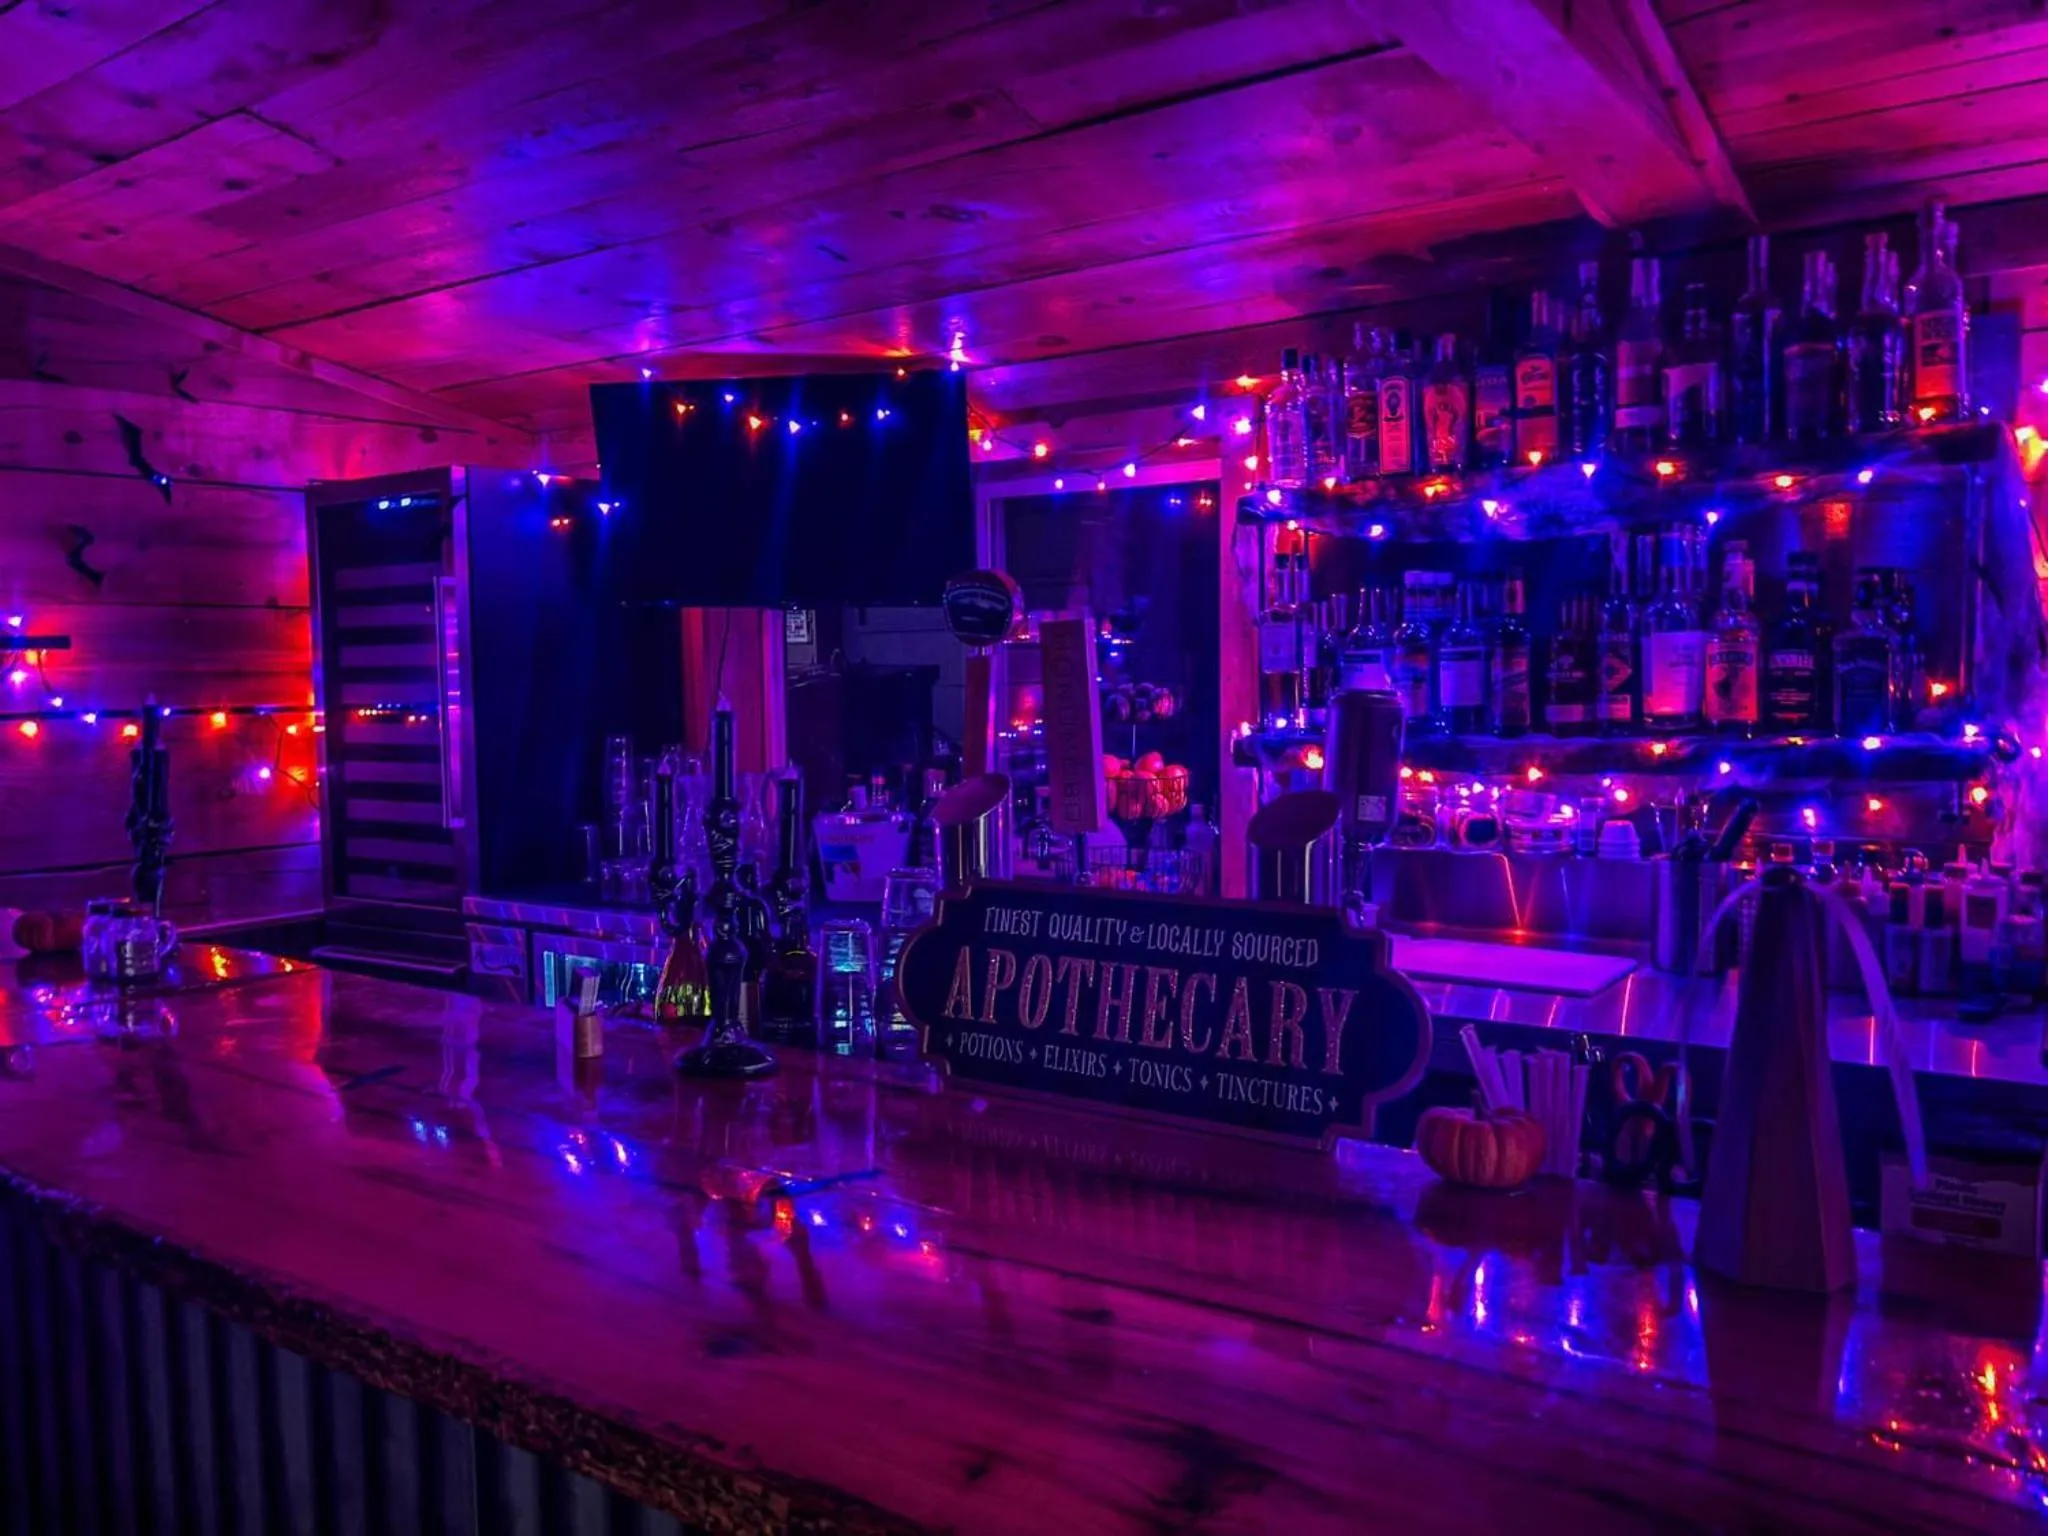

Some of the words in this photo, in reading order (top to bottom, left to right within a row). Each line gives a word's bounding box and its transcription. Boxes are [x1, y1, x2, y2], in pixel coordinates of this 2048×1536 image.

[984, 906, 1043, 937] FINEST
[1048, 912, 1128, 946] QUALITY
[1129, 926, 1145, 943] &
[1147, 922, 1224, 957] LOCALLY
[1231, 931, 1319, 967] SOURCED
[944, 945, 1360, 1075] APOTHECARY
[959, 1031, 1024, 1065] POTIONS
[1043, 1044, 1108, 1078] ELIXIRS
[1128, 1057, 1193, 1092] TONICS
[1216, 1072, 1324, 1115] TINCTURES
